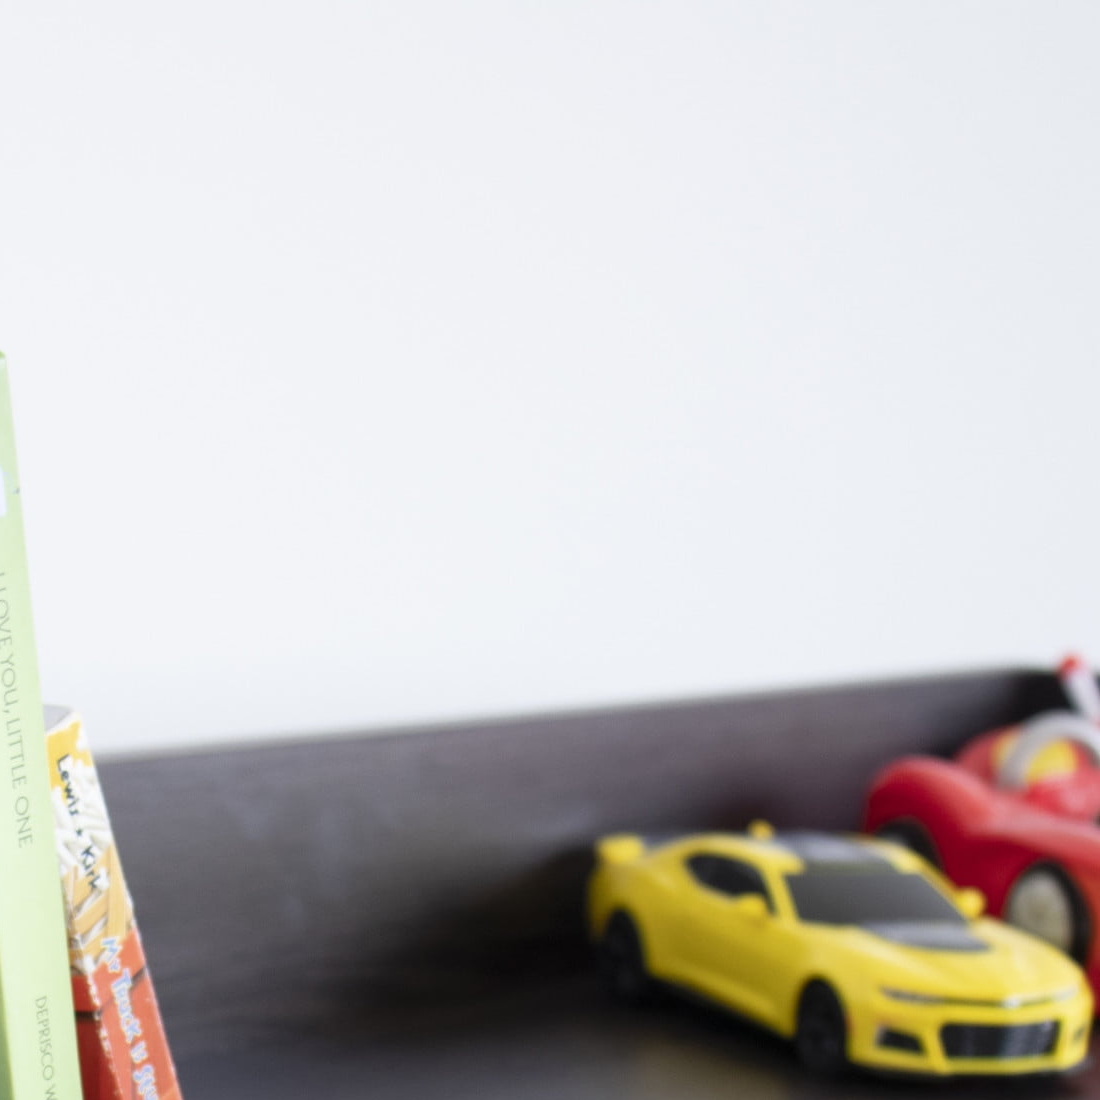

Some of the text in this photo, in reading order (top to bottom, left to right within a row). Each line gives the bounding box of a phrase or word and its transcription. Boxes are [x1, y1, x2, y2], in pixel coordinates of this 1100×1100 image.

[0, 652, 19, 713] YOU,
[6, 717, 28, 790] LITTLE
[14, 795, 33, 849] ONE
[57, 753, 80, 816] Lewis
[81, 845, 101, 890] Kirk
